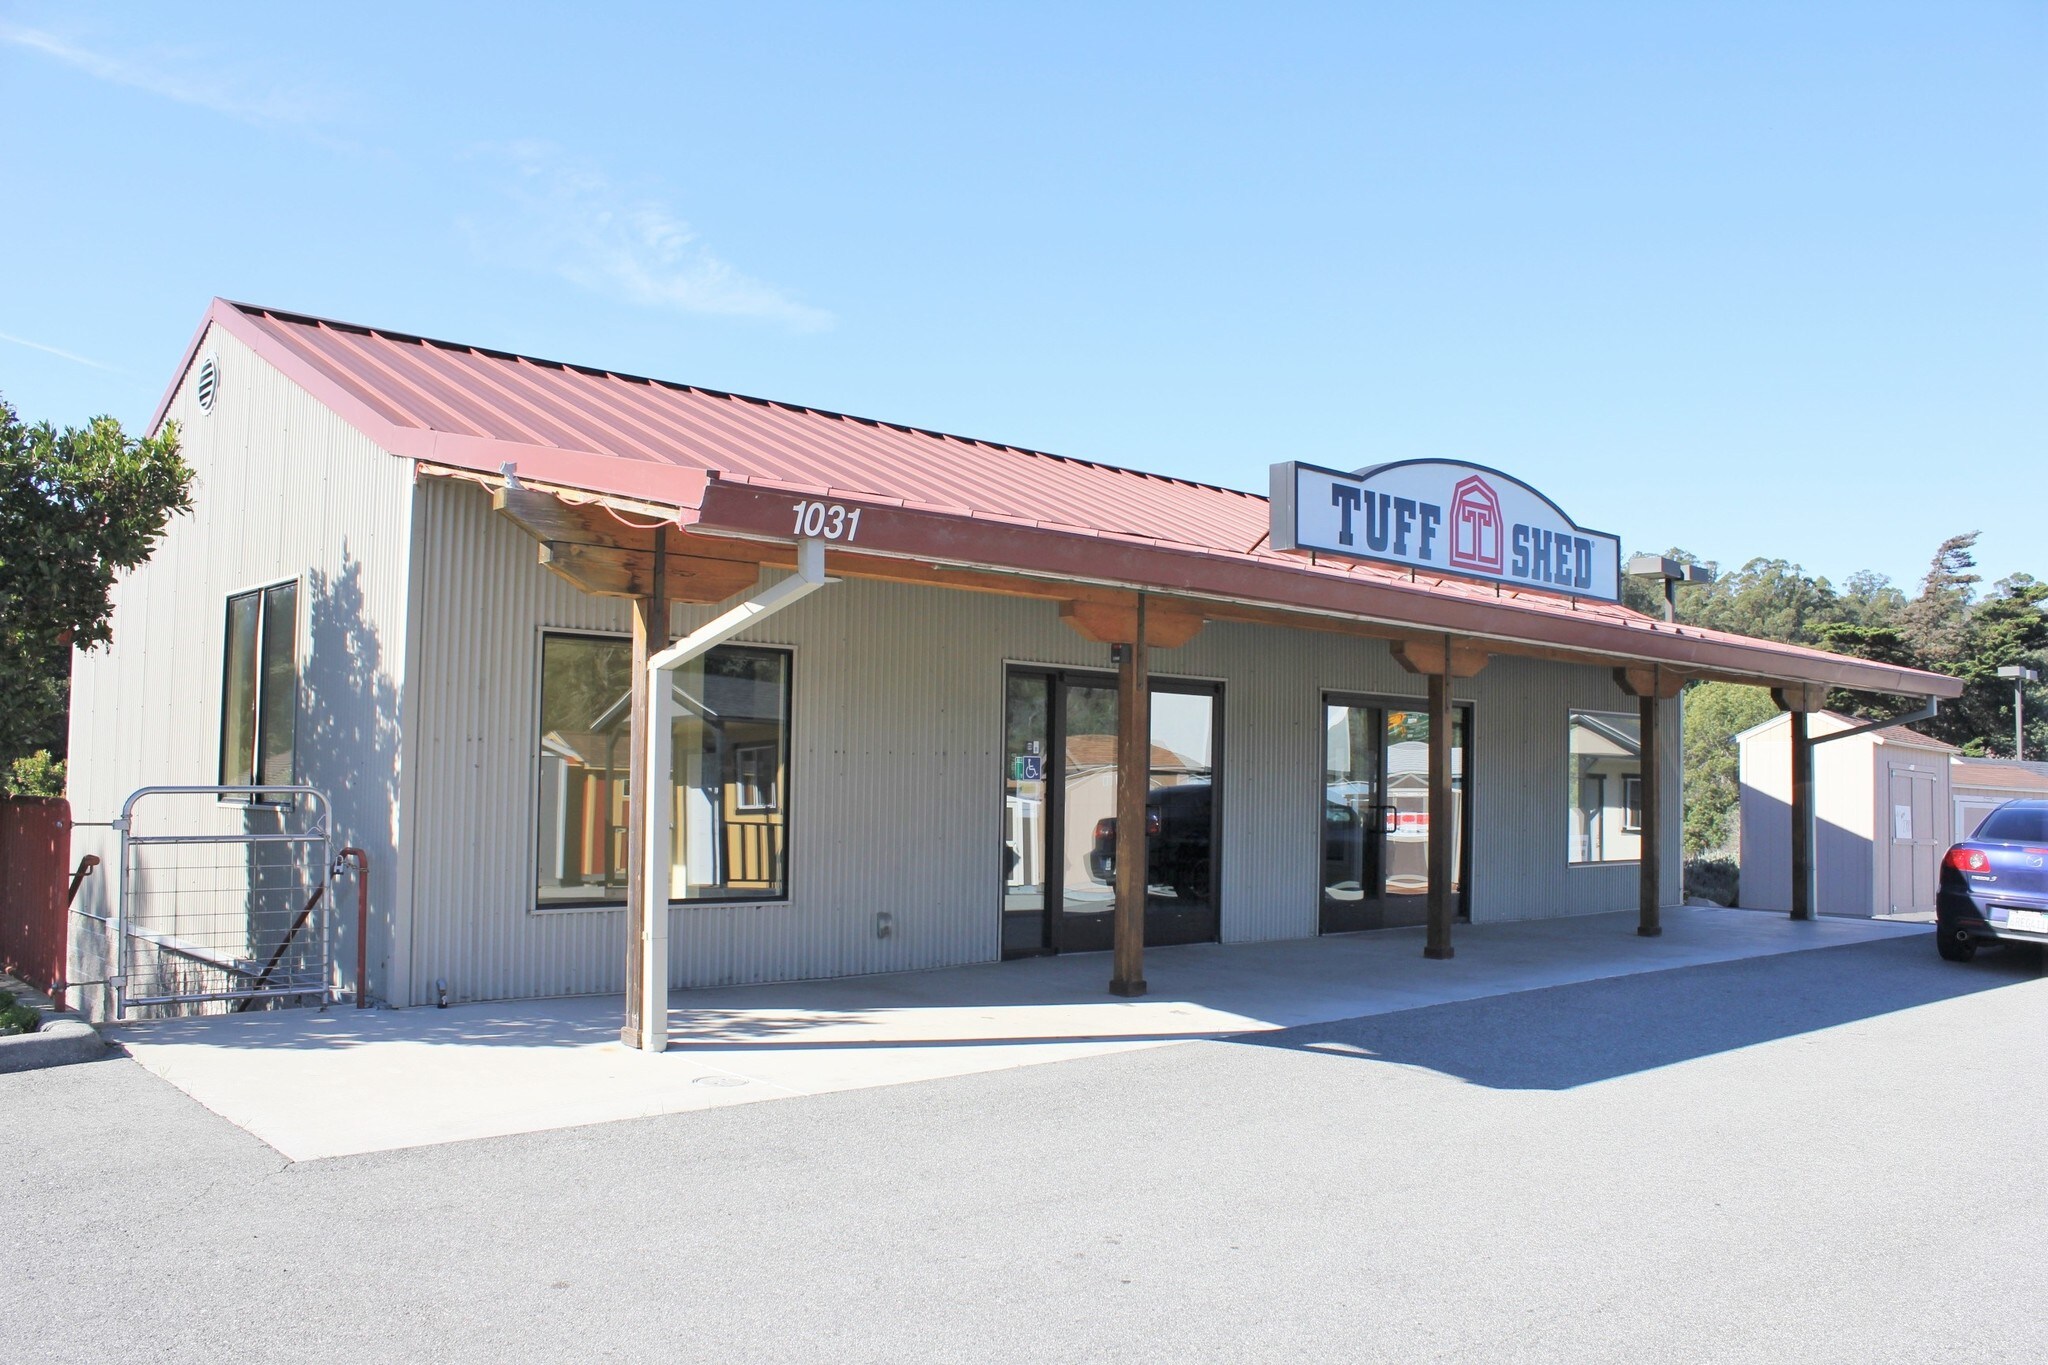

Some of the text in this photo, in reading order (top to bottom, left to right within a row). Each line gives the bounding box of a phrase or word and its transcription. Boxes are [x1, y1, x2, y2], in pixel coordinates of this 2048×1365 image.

[793, 501, 861, 541] 1031
[1332, 483, 1441, 560] TUFF
[1512, 523, 1592, 589] SHED
